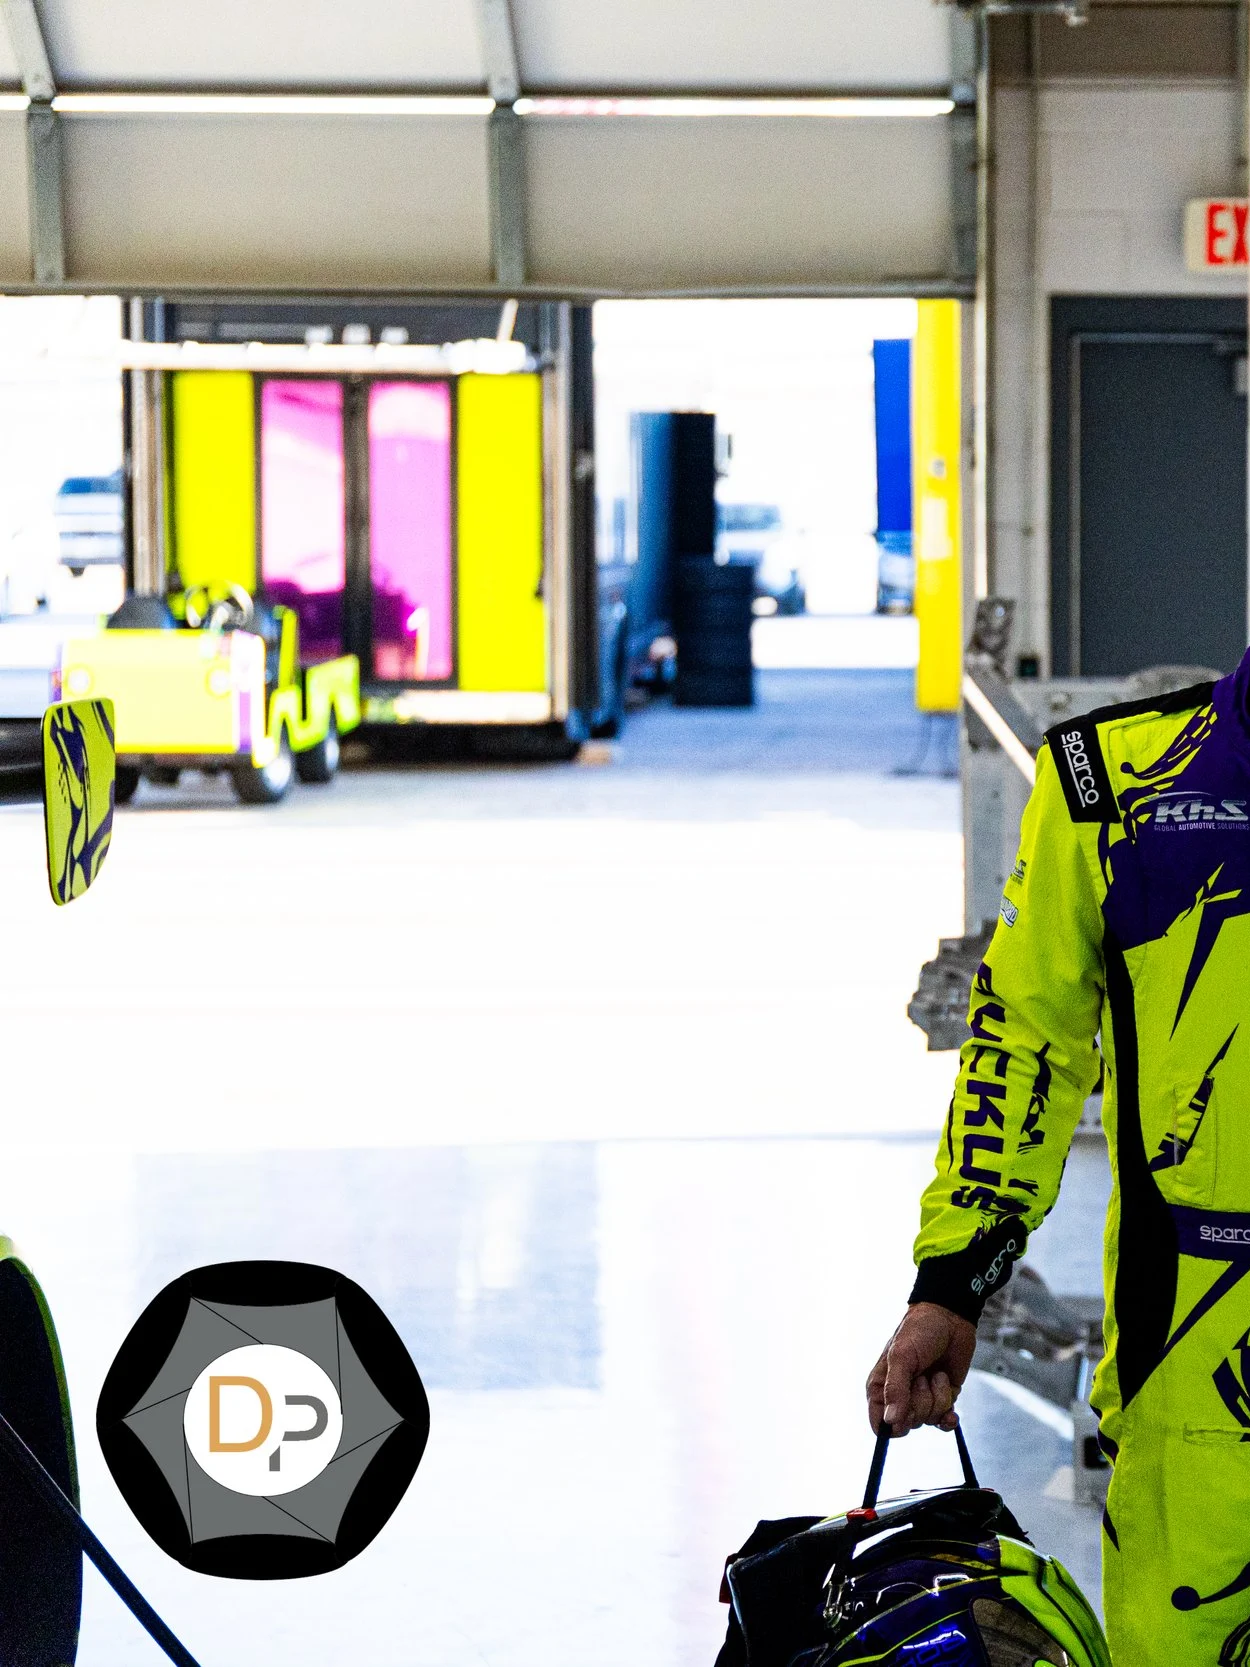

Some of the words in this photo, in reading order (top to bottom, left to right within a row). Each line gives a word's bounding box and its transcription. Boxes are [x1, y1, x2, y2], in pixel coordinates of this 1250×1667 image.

[1062, 730, 1099, 807] sparco
[1154, 824, 1177, 832] GLOBAL
[1178, 822, 1216, 831] AUTOMOTIVE
[1217, 823, 1250, 831] SOLUTIONS
